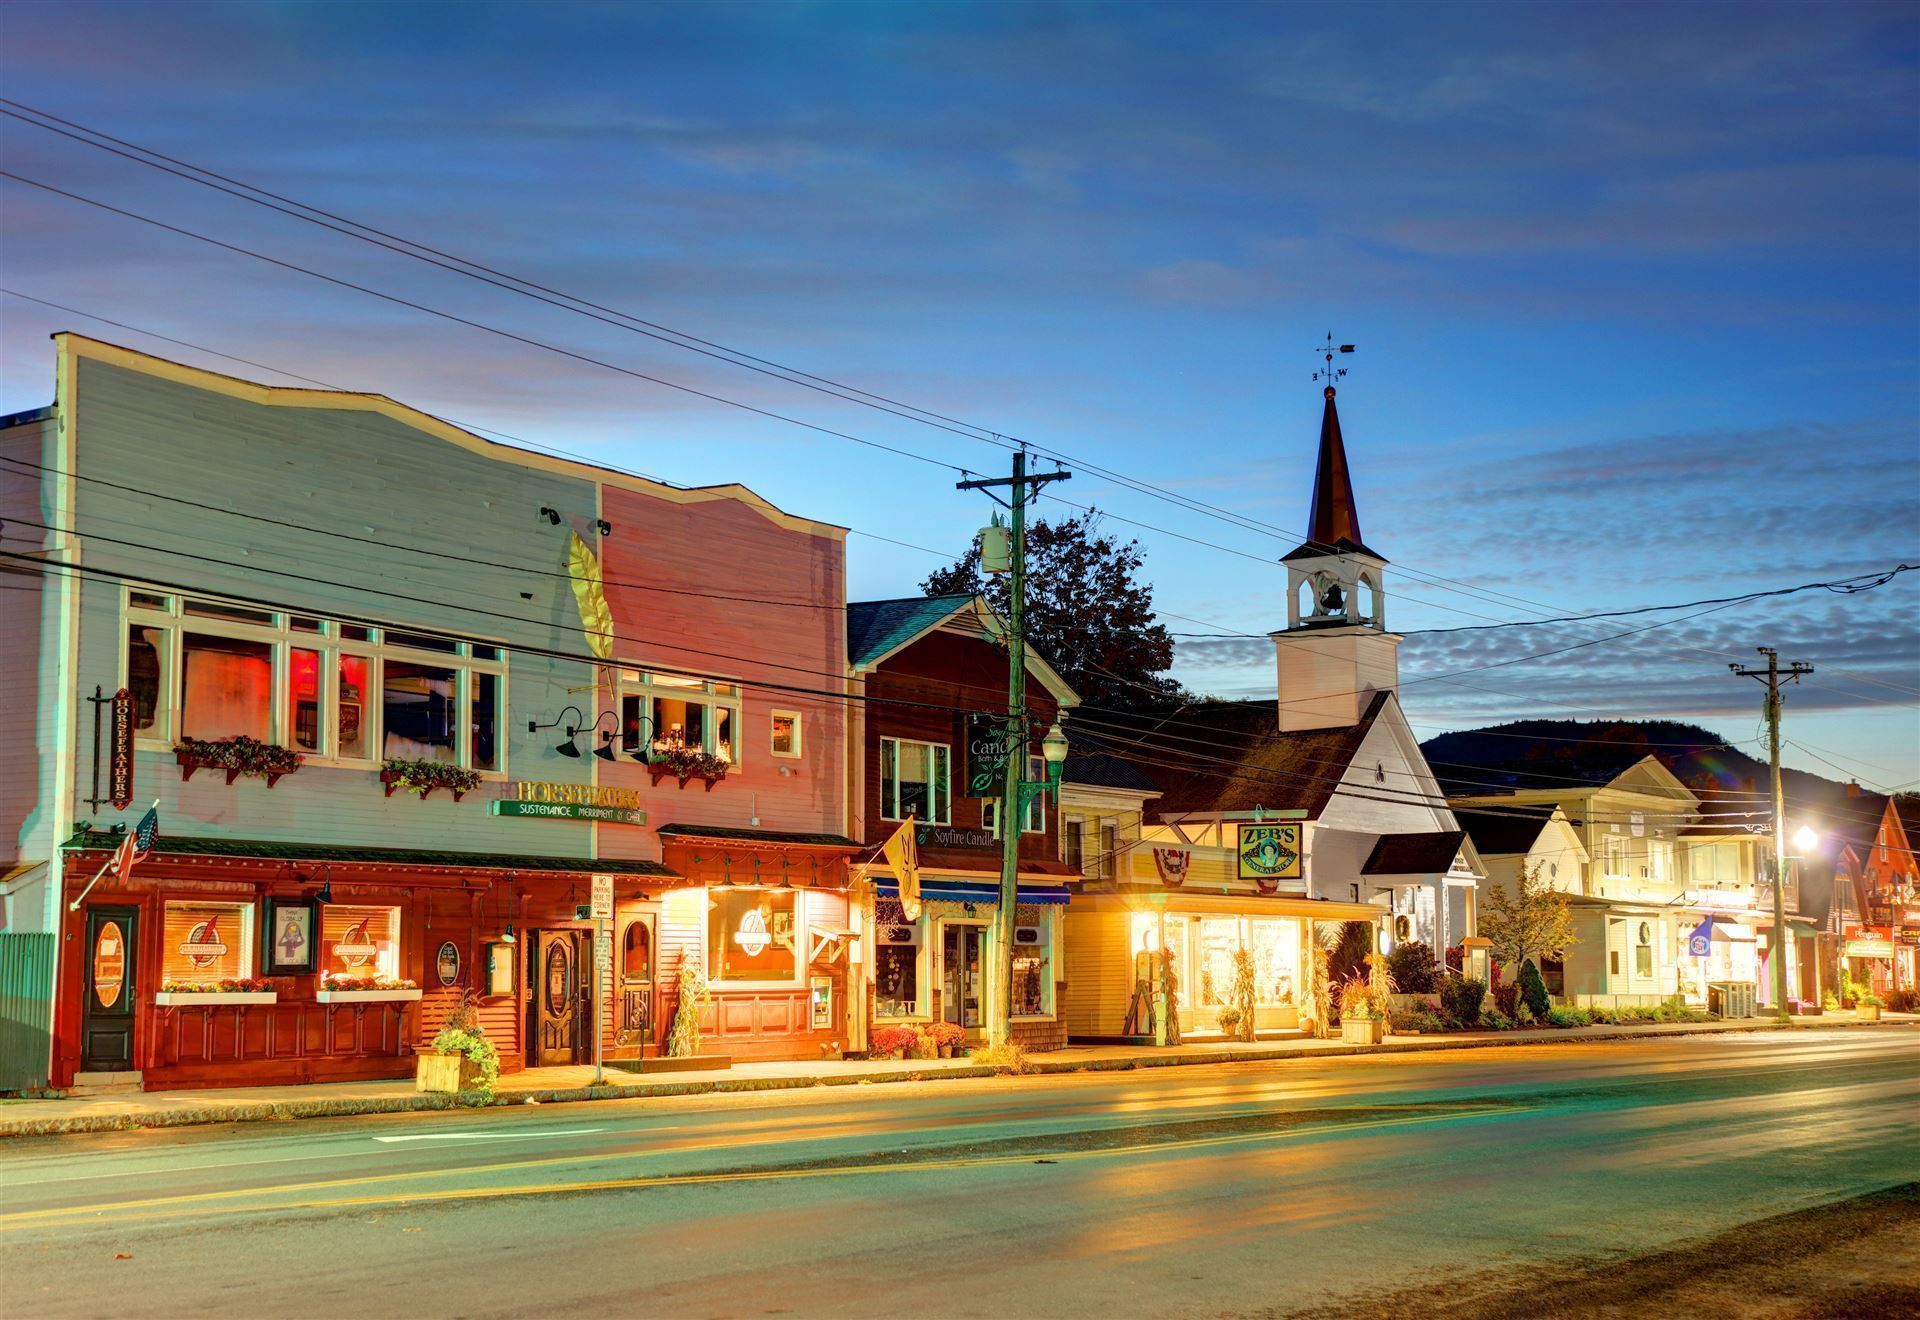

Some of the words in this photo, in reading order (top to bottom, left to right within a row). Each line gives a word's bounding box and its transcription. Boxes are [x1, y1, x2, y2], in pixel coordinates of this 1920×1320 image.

[115, 699, 129, 799] HORSEFEATHERS
[517, 781, 641, 811] HORSEFEATHERS
[578, 807, 614, 819] MERRIMENT
[934, 828, 965, 847] Soyfire
[1243, 828, 1295, 844] ZEB'S
[1244, 856, 1273, 874] GENERAL
[1274, 856, 1294, 872] STORE
[598, 877, 607, 886] NO
[593, 886, 611, 894] PARKING
[593, 901, 611, 909] CORNER
